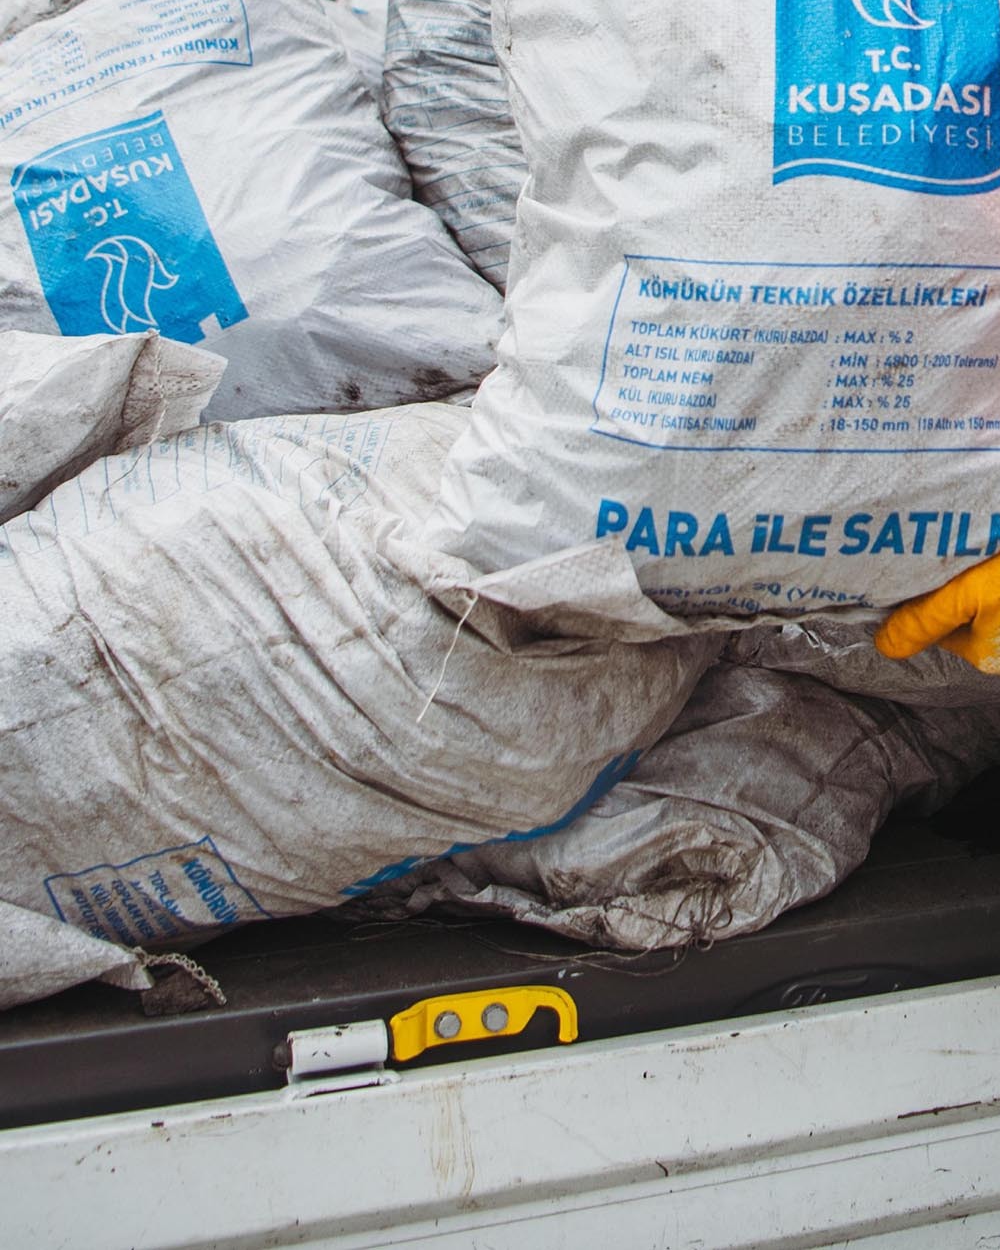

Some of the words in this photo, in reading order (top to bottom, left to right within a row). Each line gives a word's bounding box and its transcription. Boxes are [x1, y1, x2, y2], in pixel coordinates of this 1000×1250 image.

[864, 45, 921, 73] T.C.
[788, 82, 991, 116] KUŞADASI
[788, 118, 993, 151] BELEDİYESİ
[29, 153, 174, 231] KUŞADASI
[638, 275, 742, 303] KÖMÜRÜN
[750, 282, 837, 307] TEKNİK
[843, 282, 988, 307] ÖZELLİKLERİ
[631, 320, 686, 339] TOPLAM
[843, 330, 876, 343] MAX
[904, 330, 914, 343] 2
[625, 343, 652, 359] ALT
[654, 346, 680, 362] ISIL
[838, 352, 868, 367] MİN
[623, 365, 677, 383] TOPLAM
[681, 369, 714, 386] NEM
[835, 375, 868, 387] MAX
[896, 375, 914, 387] 25
[618, 386, 643, 402] KÜL
[831, 396, 864, 408] MAX
[893, 395, 911, 408] 25
[610, 407, 658, 426] BOYUT
[830, 418, 878, 431] 18-150
[882, 421, 910, 431] mm
[596, 498, 735, 557] PARA
